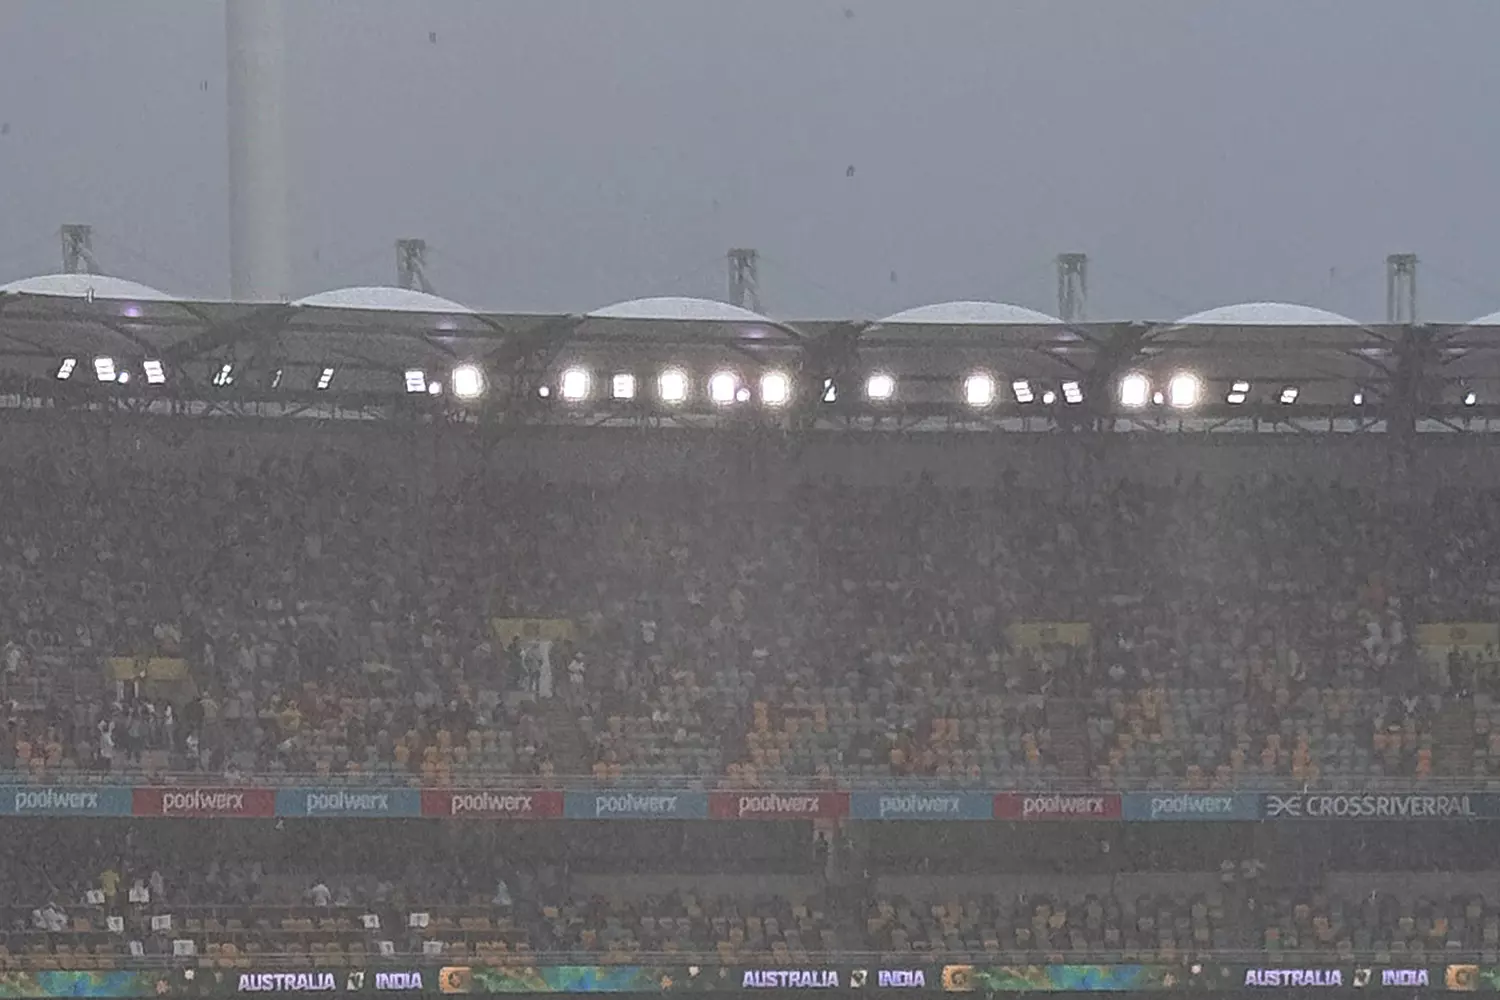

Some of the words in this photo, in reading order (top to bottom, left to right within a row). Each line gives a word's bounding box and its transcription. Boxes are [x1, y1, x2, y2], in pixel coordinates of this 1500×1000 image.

[238, 971, 336, 991] AUSTRALIA
[375, 971, 424, 990] INDIA
[742, 970, 839, 988] AUSTRALIA
[878, 969, 926, 988] INDIA
[1244, 968, 1343, 987] AUSTRALIA
[1381, 968, 1429, 987] INDIA
